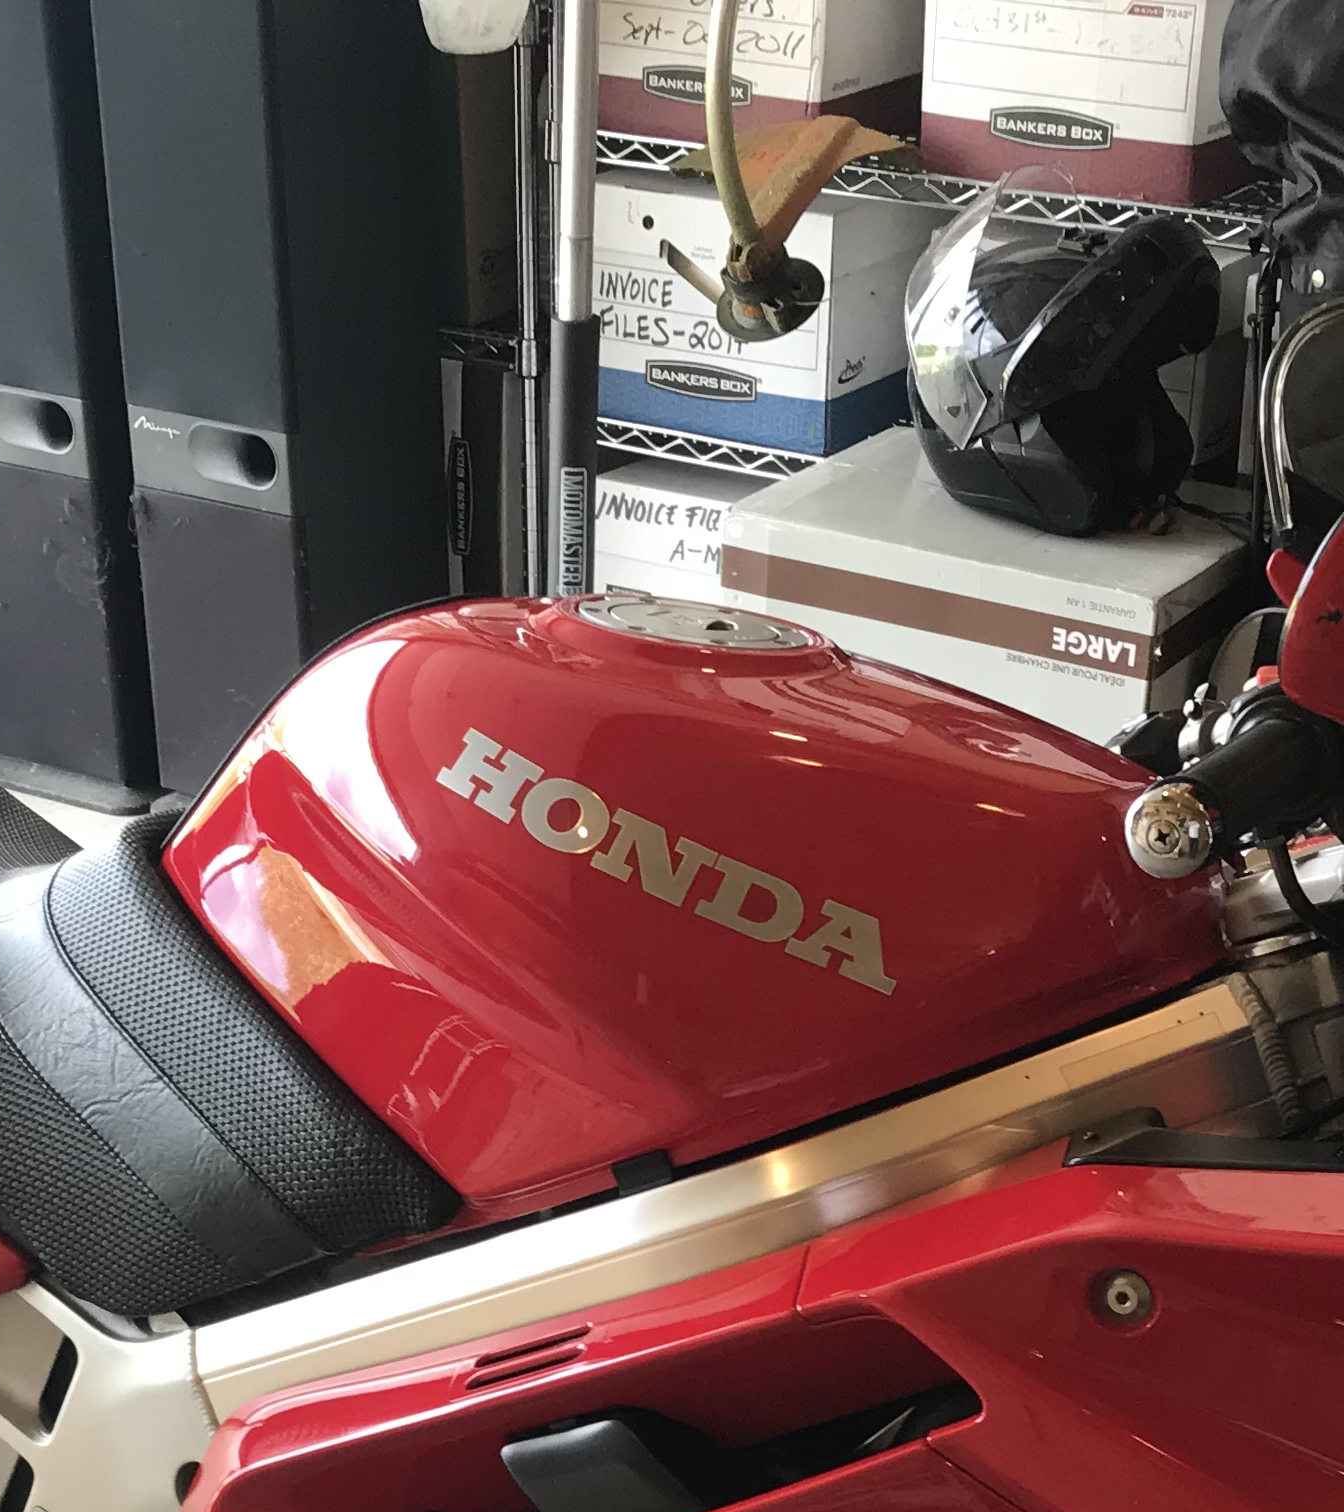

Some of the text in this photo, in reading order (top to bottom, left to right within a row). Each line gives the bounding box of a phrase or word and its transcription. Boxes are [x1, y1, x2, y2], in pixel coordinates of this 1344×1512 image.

[736, 29, 805, 59] 2011
[648, 74, 708, 95] BANKER
[996, 116, 1103, 142] BANKERS BOX
[599, 270, 674, 307] INVOICE
[651, 366, 751, 395] BANKERS BOX
[595, 492, 679, 525] INVOICE
[562, 470, 585, 586] MOTOMASTER
[1066, 596, 1082, 607] AN
[1089, 600, 1136, 619] GARANTIE
[1052, 626, 1136, 667] LARGE
[1006, 651, 1125, 687] IDÉAL POUR UNE CHAMBRE
[436, 727, 897, 996] HONDA
